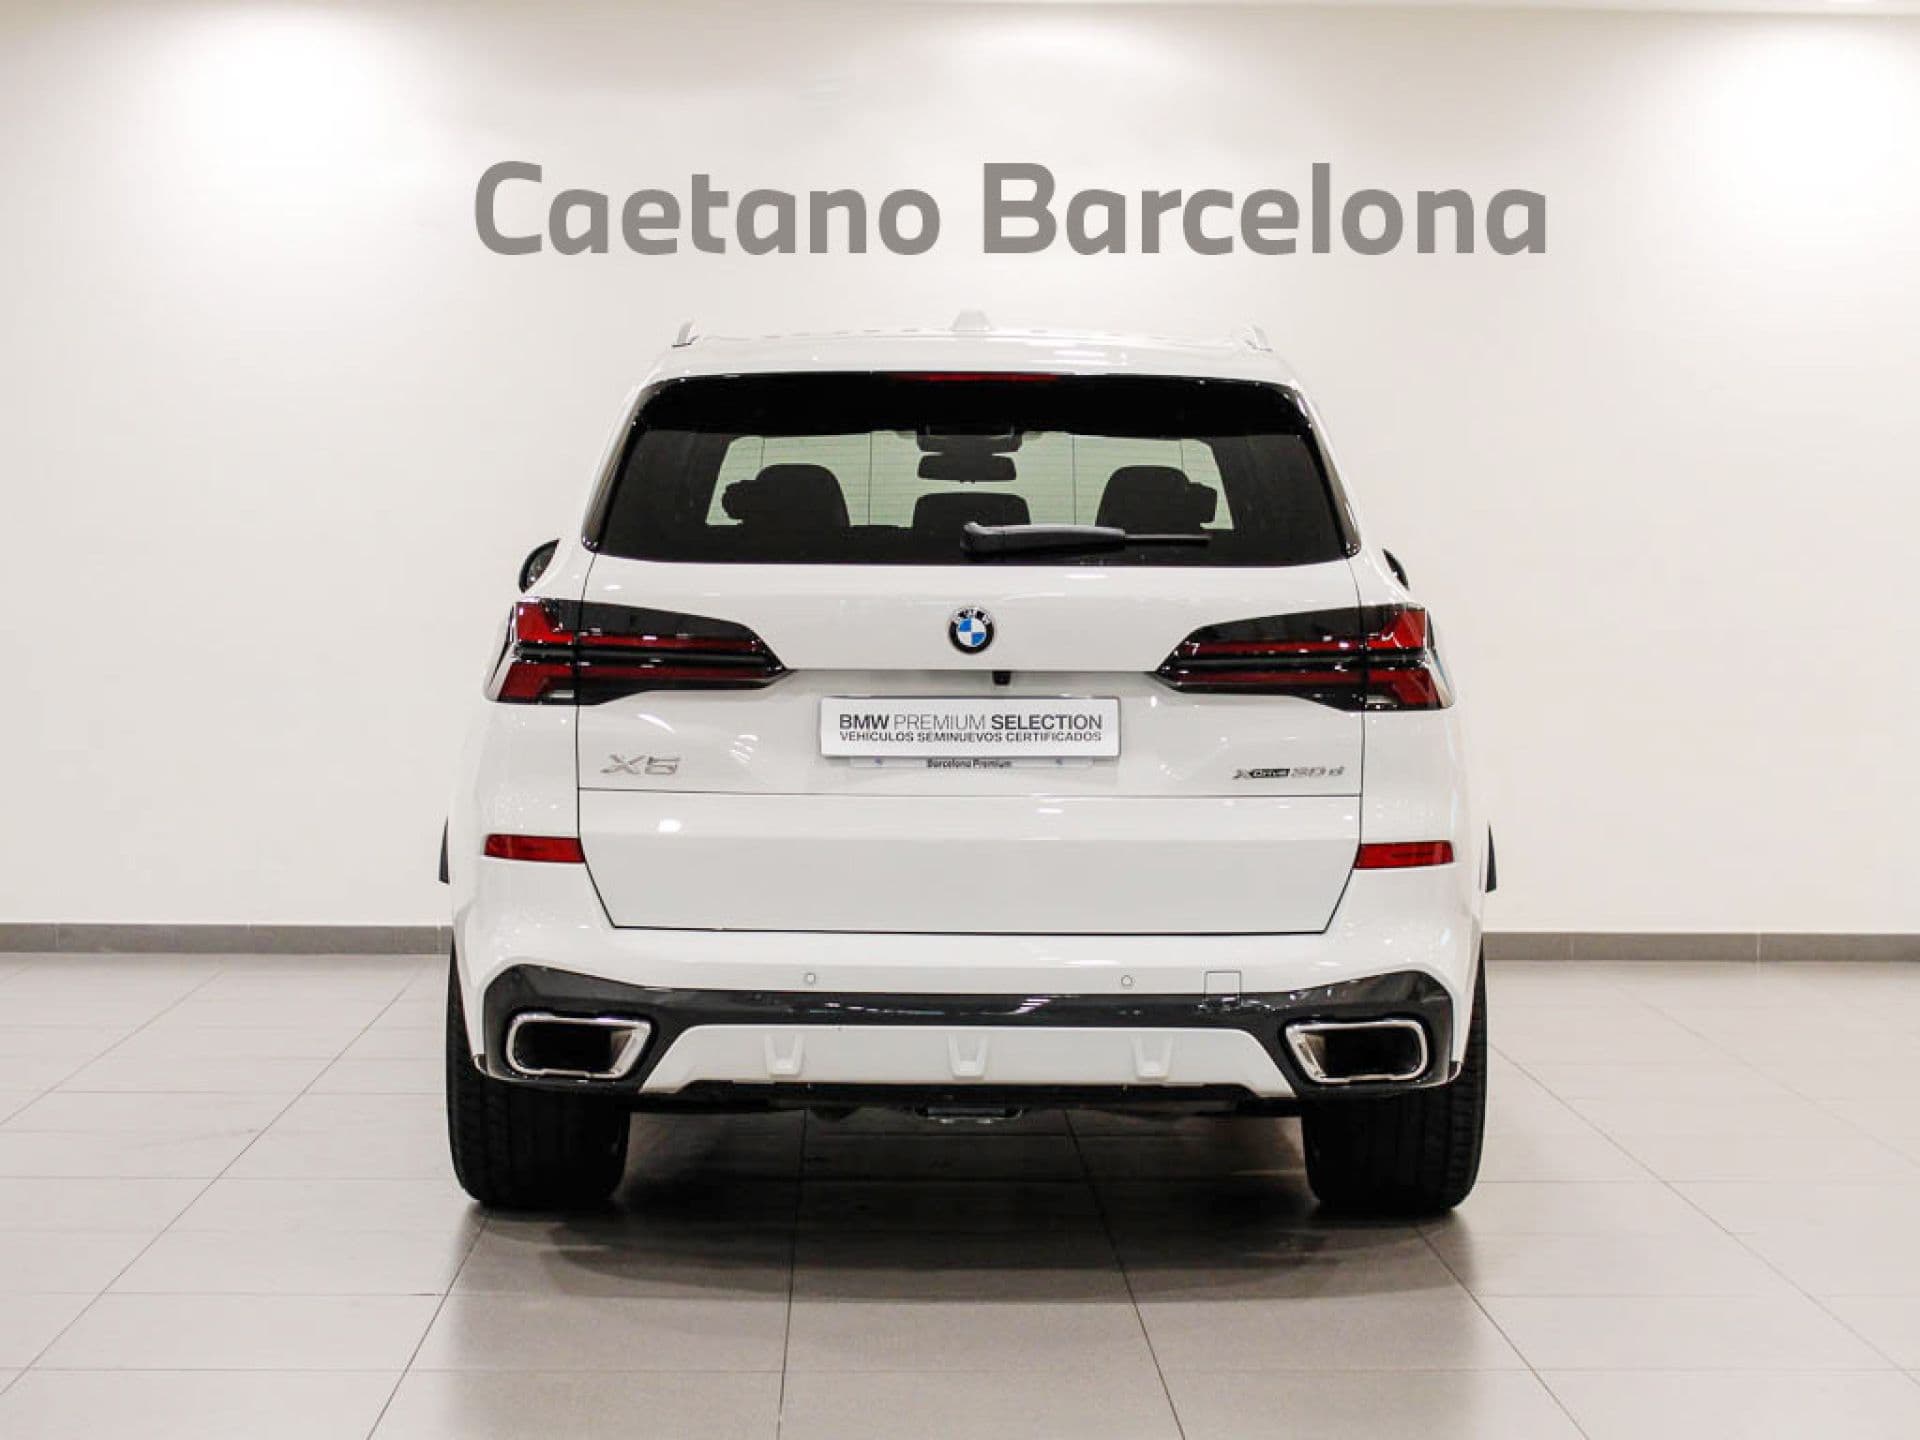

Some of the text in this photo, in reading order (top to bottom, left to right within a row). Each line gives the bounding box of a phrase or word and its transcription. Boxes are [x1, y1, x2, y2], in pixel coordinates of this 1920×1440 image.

[839, 713, 1103, 731] BMW PREMIUM SELECTION
[916, 731, 1004, 743] SEMINUEVOS
[1005, 731, 1103, 743] CERTIFICADOS
[600, 754, 680, 775] X5
